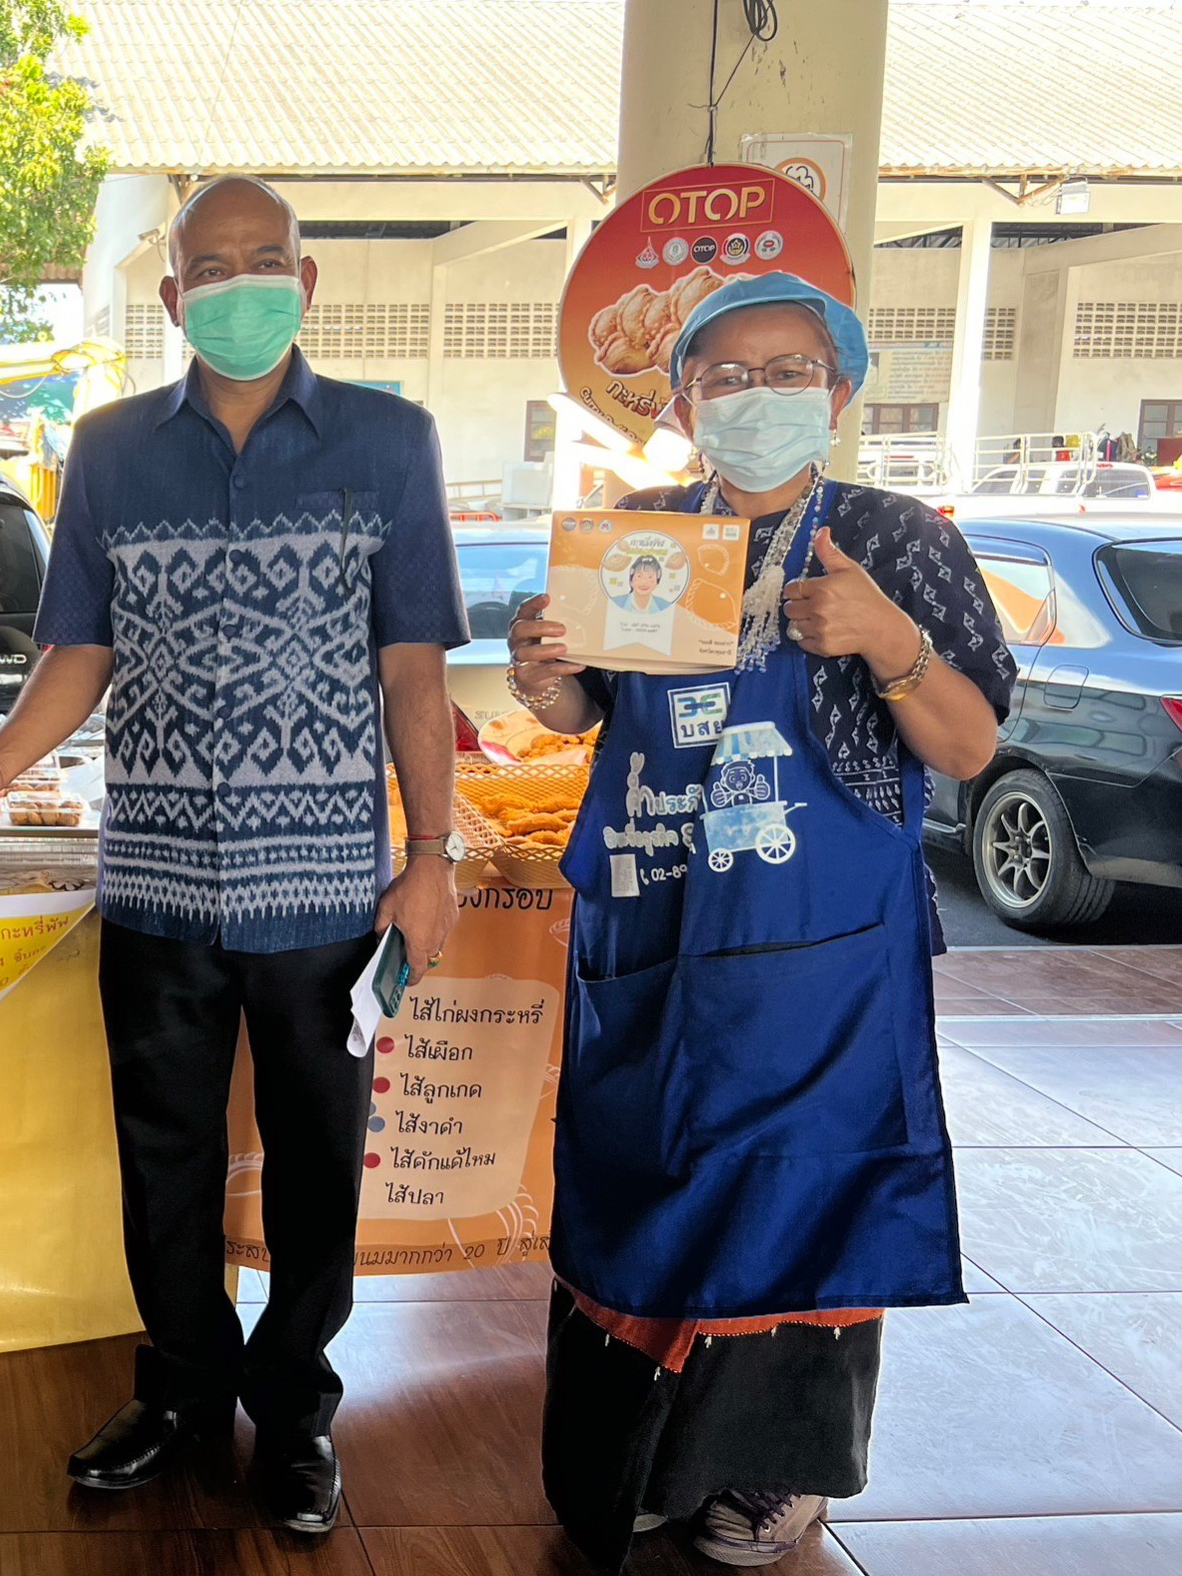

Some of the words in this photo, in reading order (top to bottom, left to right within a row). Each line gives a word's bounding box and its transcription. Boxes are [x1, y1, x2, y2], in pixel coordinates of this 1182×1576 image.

[648, 186, 766, 226] OTOP
[693, 245, 716, 253] OTOP
[409, 996, 545, 1024] ไส้ไก่ผงกระหรี่
[404, 1034, 473, 1061] ไส้เผือก
[400, 1072, 482, 1104] ไส้ลูกเกด
[395, 1110, 463, 1135] ไส้งาดำ
[390, 1146, 496, 1171] ไส้ดักแด้ไหม
[385, 1182, 445, 1205] ไส้ปลา
[354, 1241, 453, 1266] นมมากกว่า
[463, 1243, 485, 1261] 20
